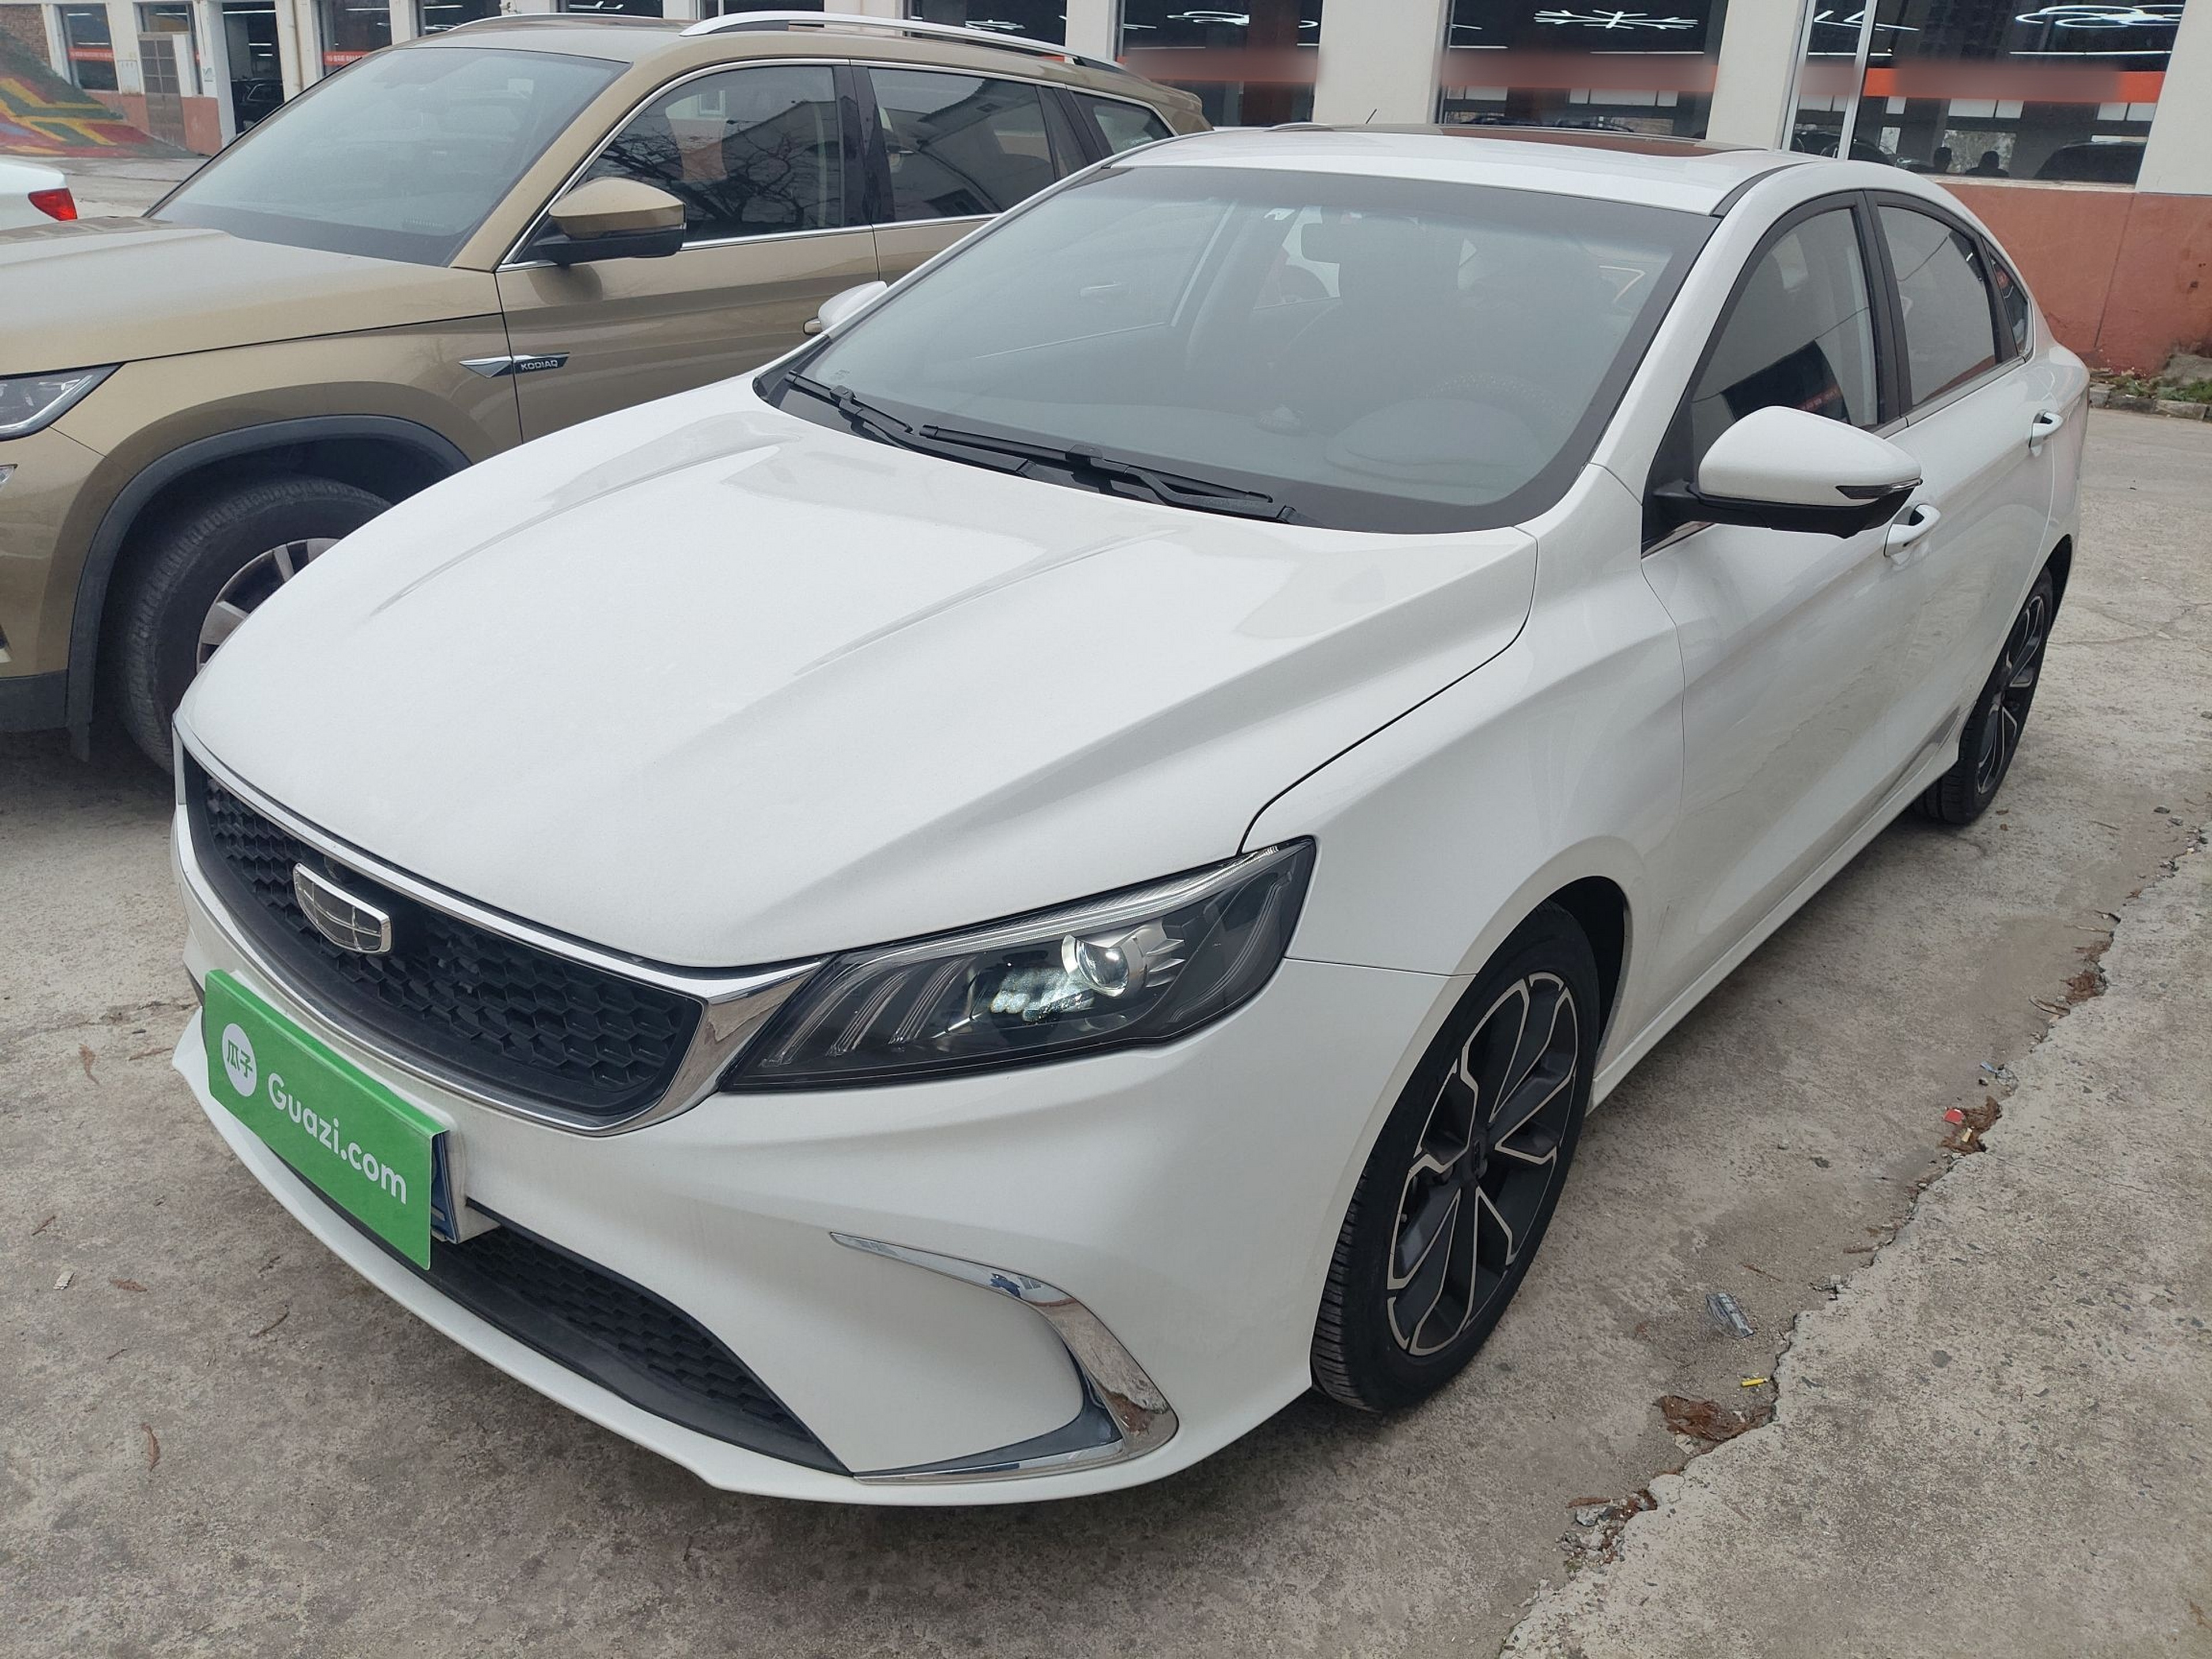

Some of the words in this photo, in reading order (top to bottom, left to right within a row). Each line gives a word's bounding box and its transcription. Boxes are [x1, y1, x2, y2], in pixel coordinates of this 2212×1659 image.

[521, 360, 558, 370] KODIAQ
[227, 1039, 253, 1078] 瓜子
[268, 1073, 407, 1205] Guazi.com
